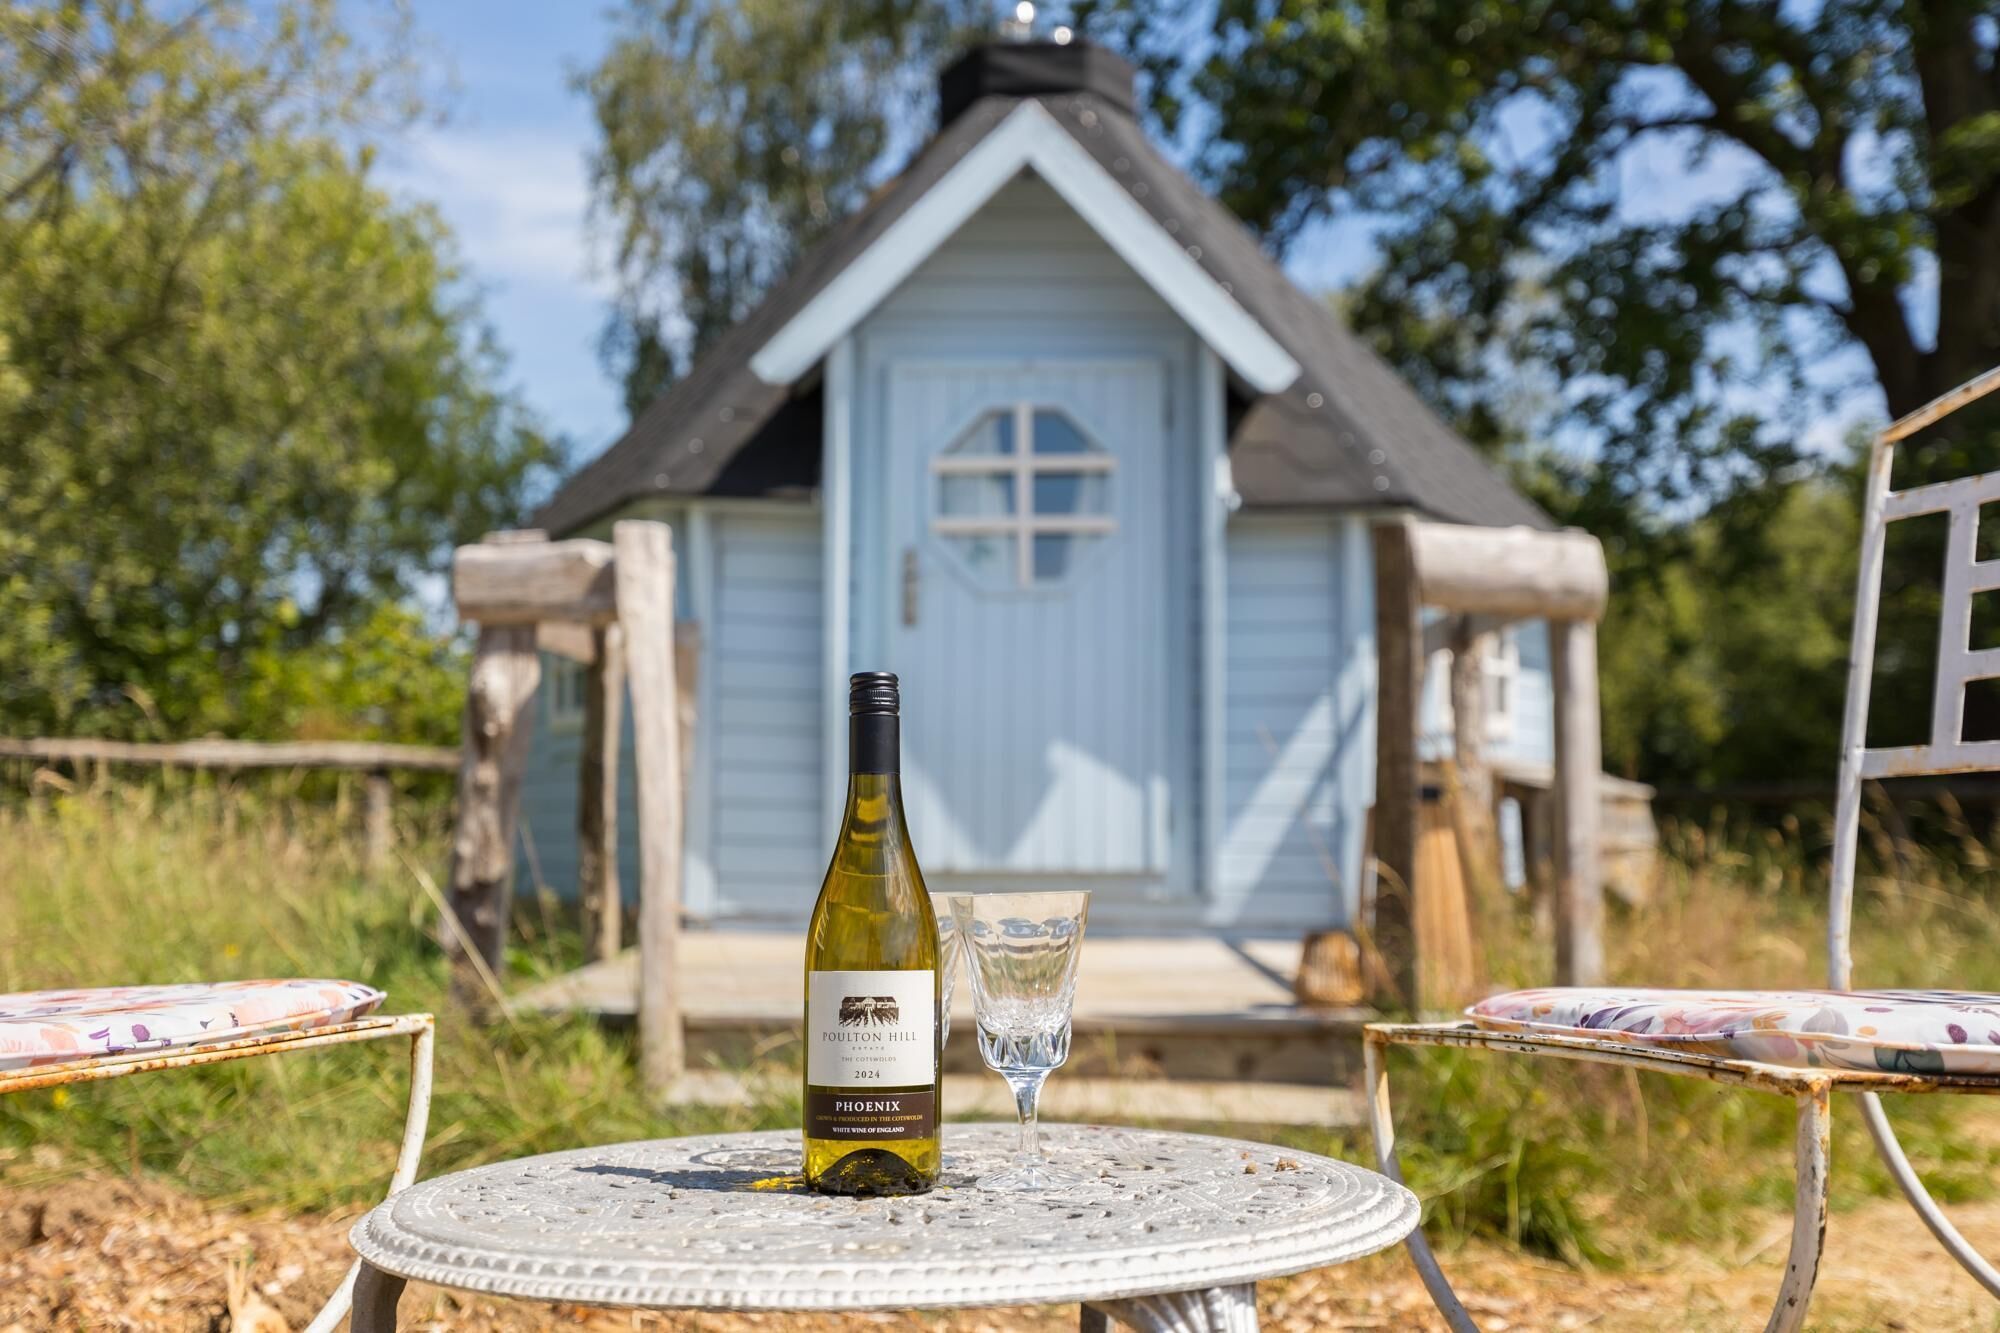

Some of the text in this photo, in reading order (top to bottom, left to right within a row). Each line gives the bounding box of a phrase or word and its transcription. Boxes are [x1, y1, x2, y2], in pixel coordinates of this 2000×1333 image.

[822, 1031, 917, 1042] POULTON HILL
[854, 1070, 881, 1079] 2024
[835, 1101, 901, 1112] PHOENIX
